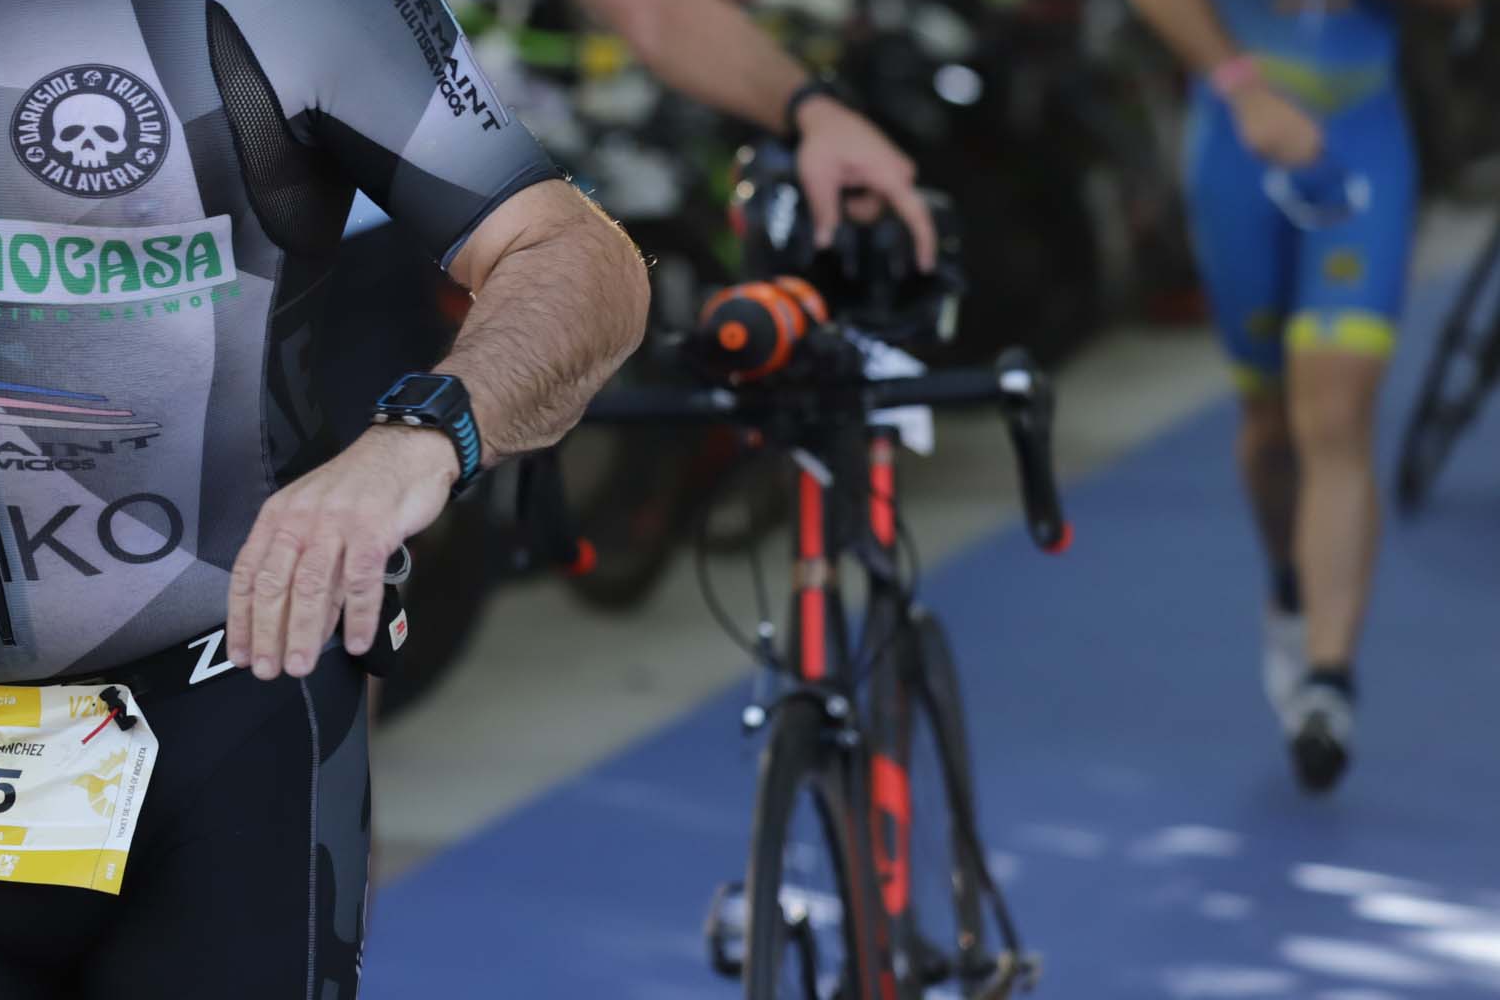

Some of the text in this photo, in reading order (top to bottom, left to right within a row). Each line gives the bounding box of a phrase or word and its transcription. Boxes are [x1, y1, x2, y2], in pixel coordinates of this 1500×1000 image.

[18, 72, 162, 145] DARKSIDE TRIATLON
[41, 159, 145, 192] TALAVERA
